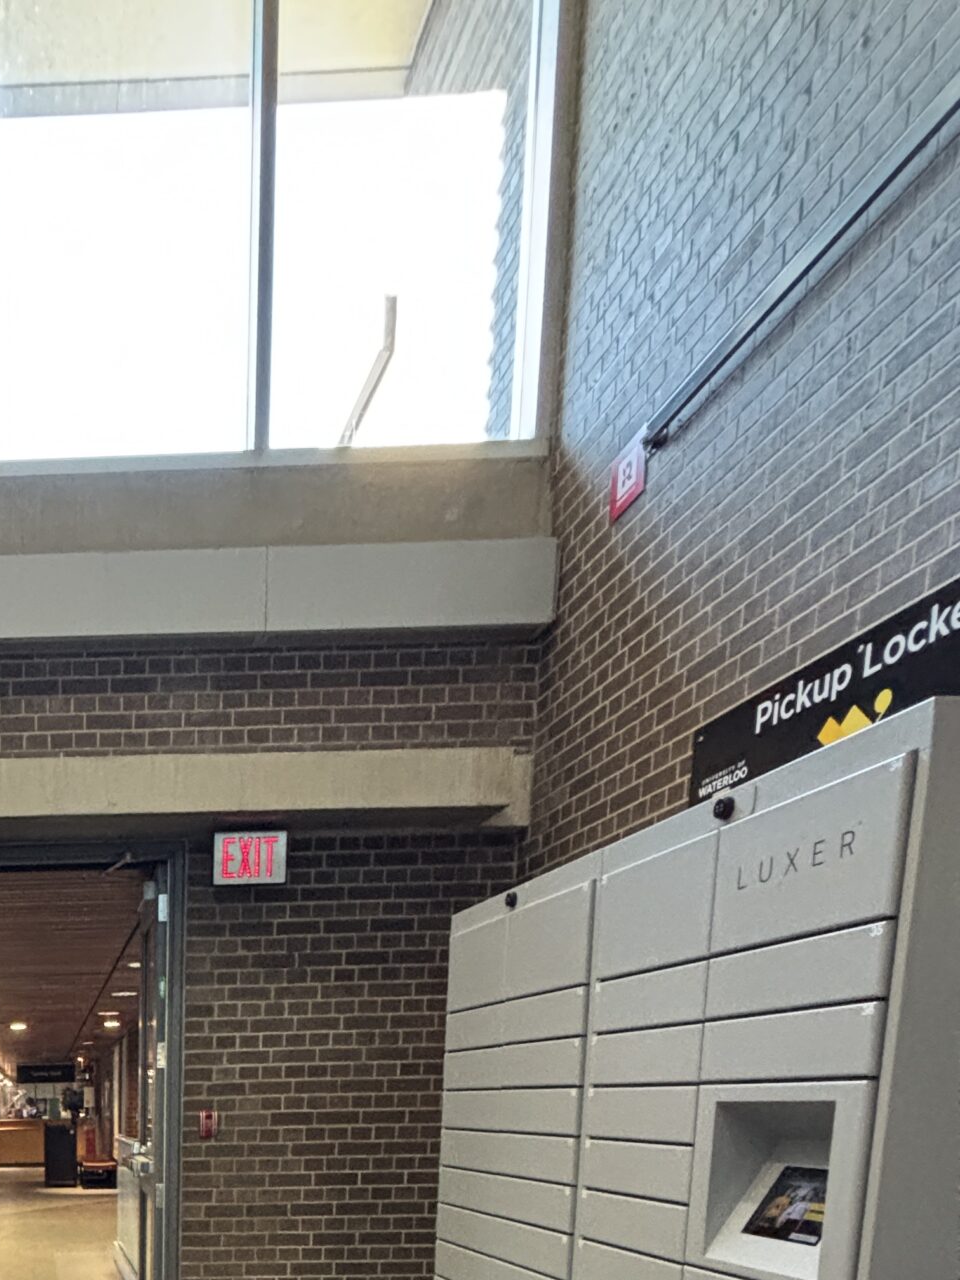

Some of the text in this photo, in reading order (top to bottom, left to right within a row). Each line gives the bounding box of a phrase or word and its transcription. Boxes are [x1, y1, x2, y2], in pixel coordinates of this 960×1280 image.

[754, 663, 852, 735] Pickup
[698, 766, 748, 798] WATERLOO
[222, 835, 280, 879] EXIT
[737, 830, 855, 890] LUXER
